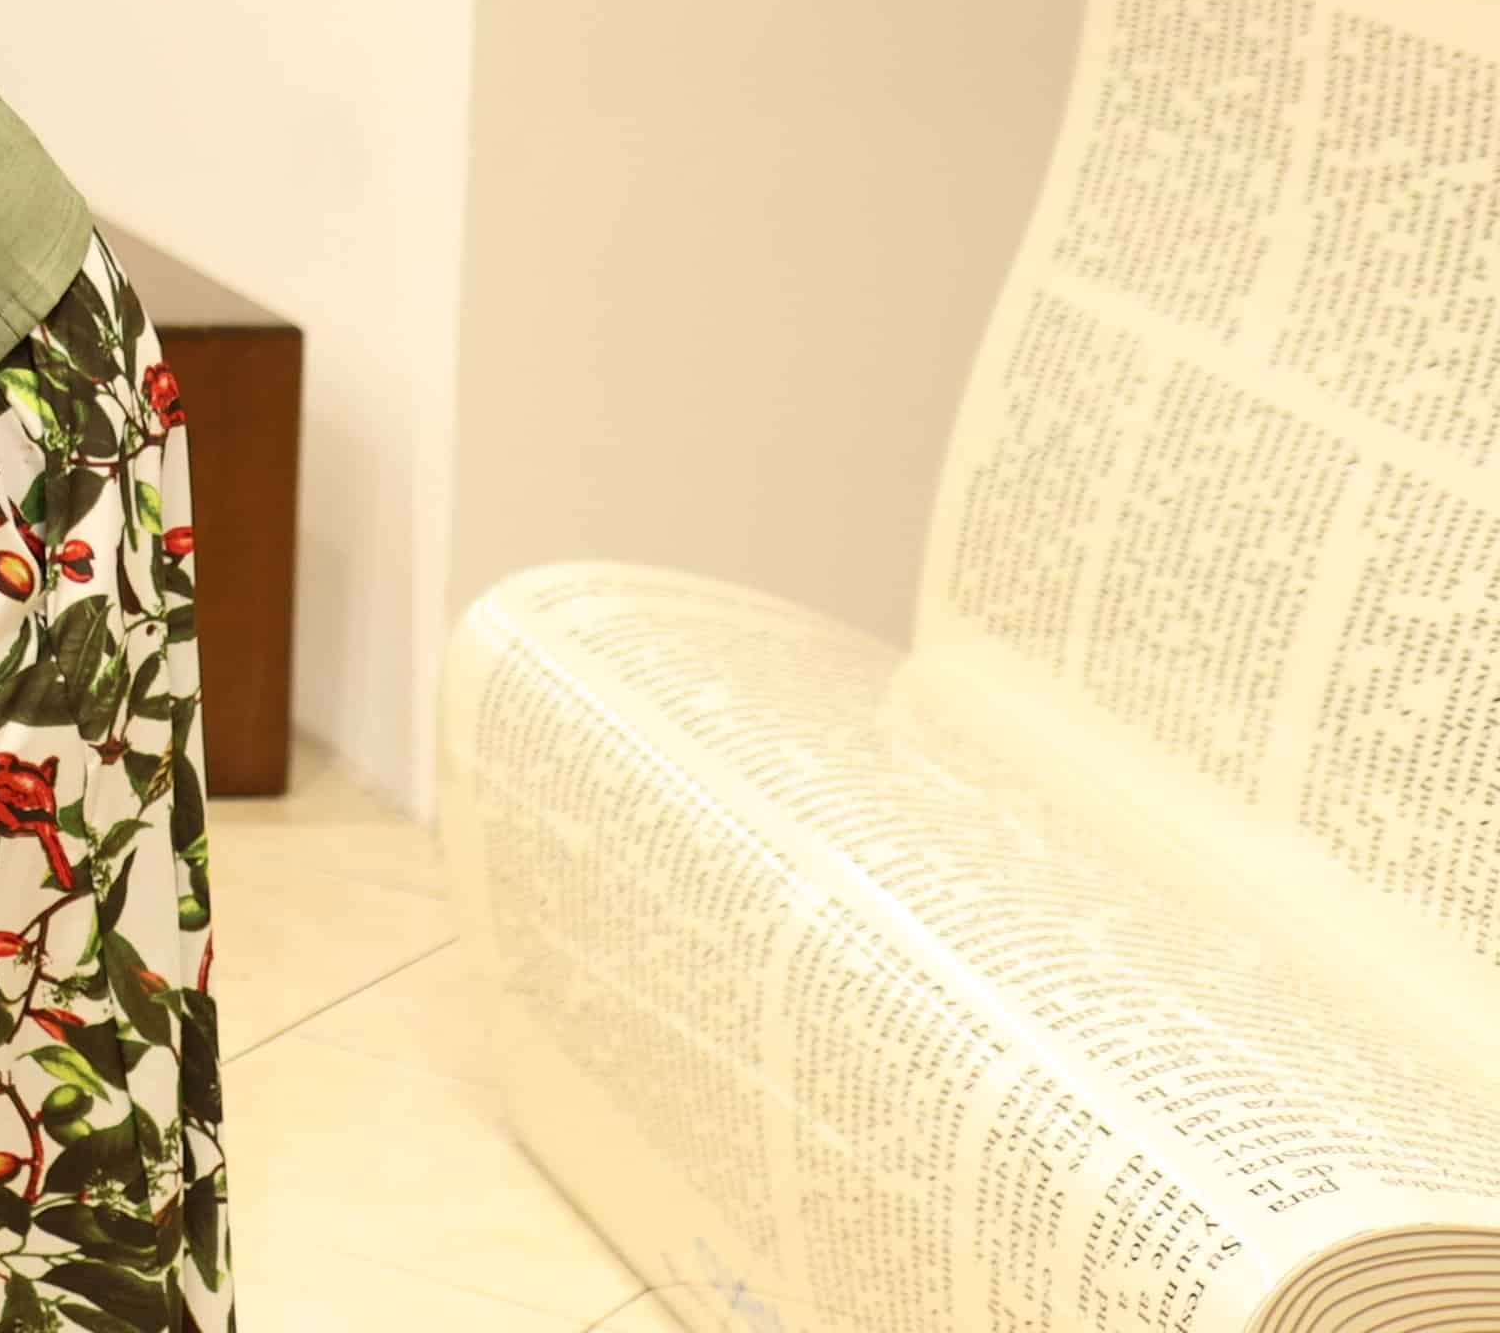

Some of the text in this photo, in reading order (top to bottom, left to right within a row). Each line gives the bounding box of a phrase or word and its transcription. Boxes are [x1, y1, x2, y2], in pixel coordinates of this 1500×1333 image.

[1174, 1109, 1221, 1136] del
[1069, 1124, 1112, 1173] Los
[1105, 1154, 1145, 1206] dad
[1249, 1164, 1334, 1197] de la
[1268, 1179, 1341, 1213] para
[1123, 1185, 1182, 1268] abajo.
[1152, 1202, 1205, 1270] lante
[1177, 1239, 1201, 1273] su
[1207, 1234, 1242, 1270] Su
